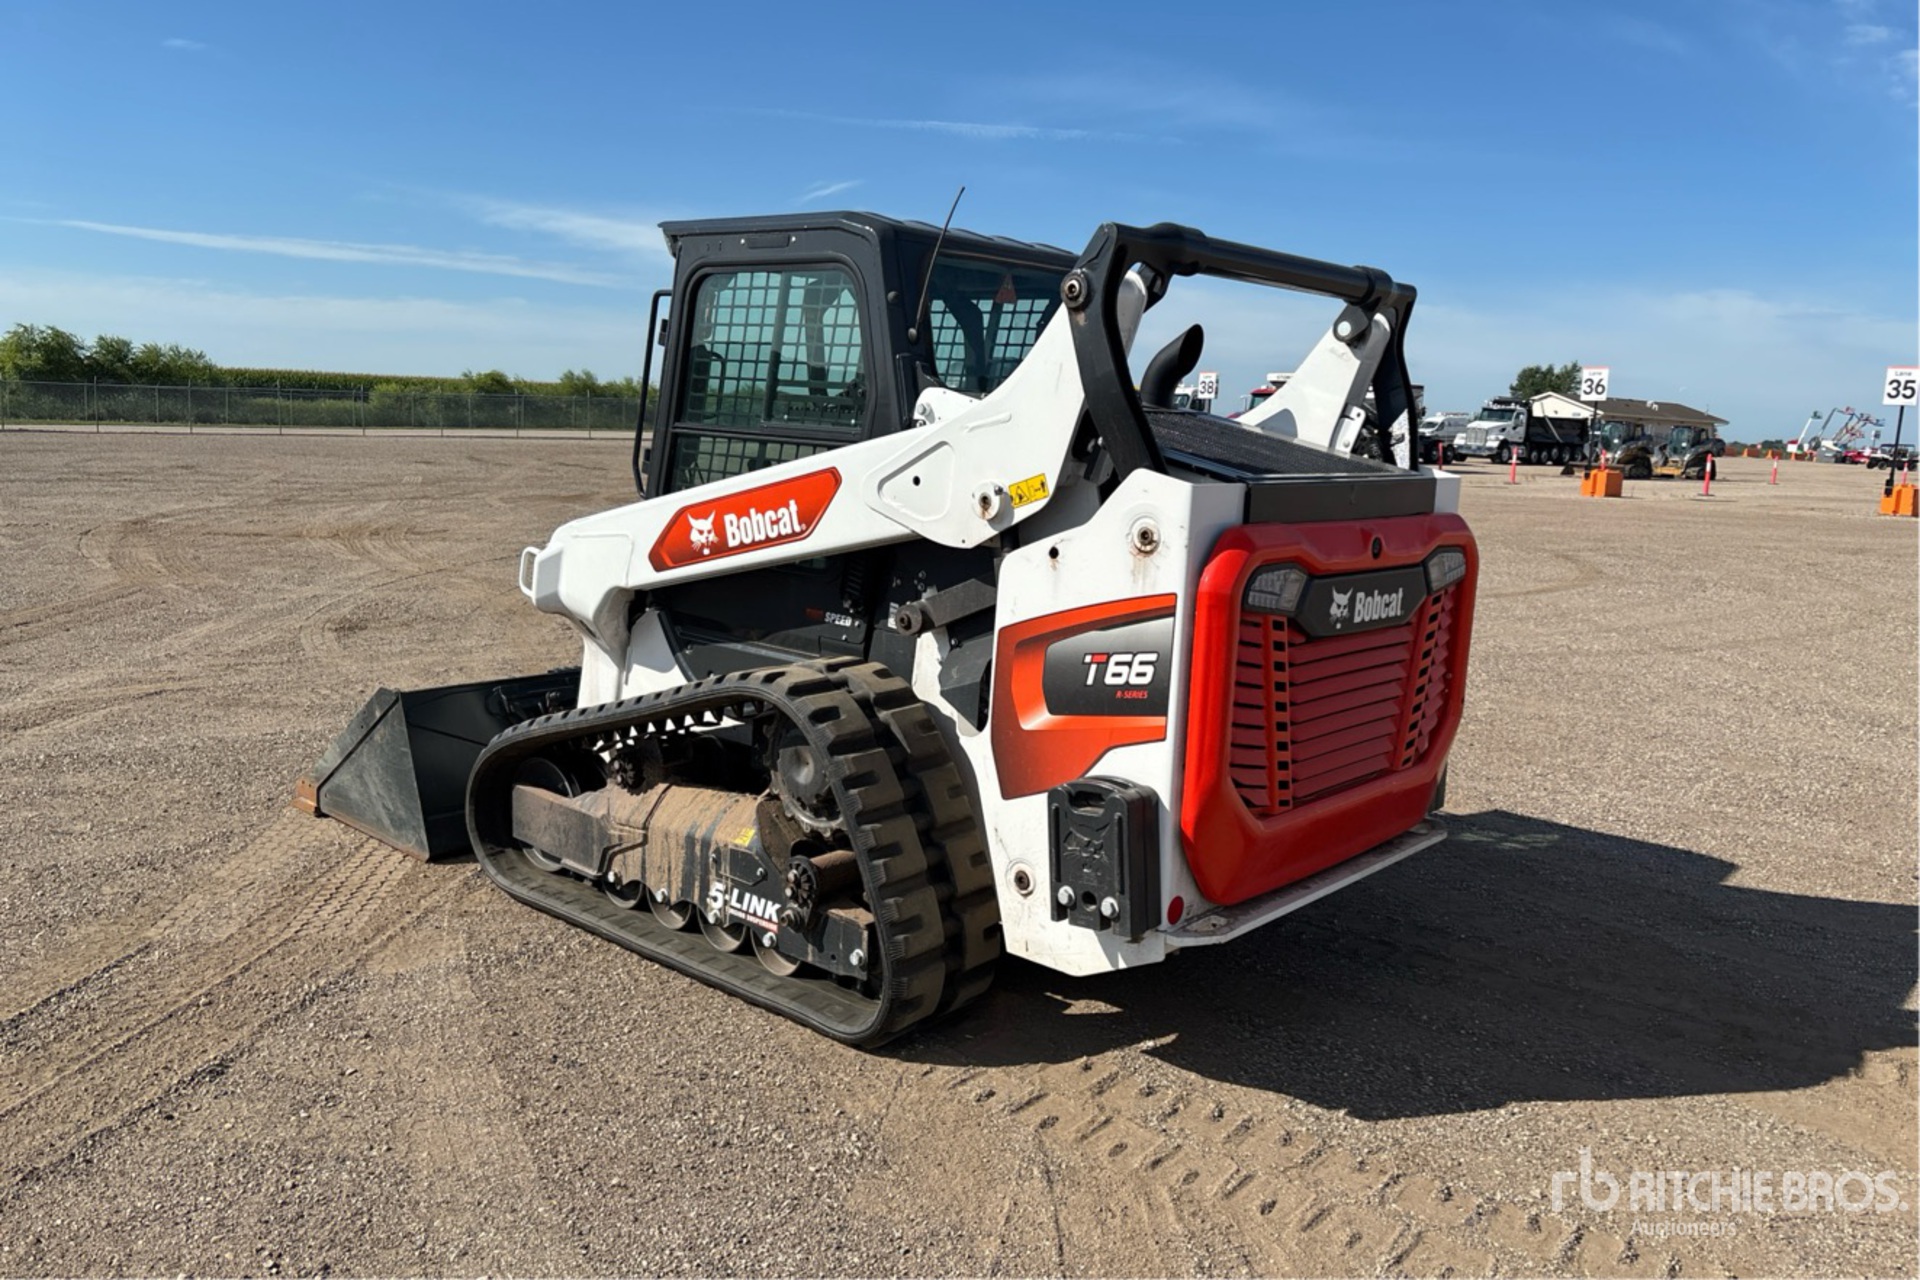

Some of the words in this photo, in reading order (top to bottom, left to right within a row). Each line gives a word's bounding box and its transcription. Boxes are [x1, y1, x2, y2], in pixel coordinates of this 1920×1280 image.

[1200, 381, 1215, 394] 38
[1583, 378, 1606, 395] 36
[1887, 379, 1916, 399] 35
[723, 499, 801, 548] Bobcat
[1353, 587, 1403, 623] Bobcat
[1084, 652, 1159, 686] T66
[1116, 690, 1148, 699] R-SERIES
[707, 881, 782, 923] 5-LINK
